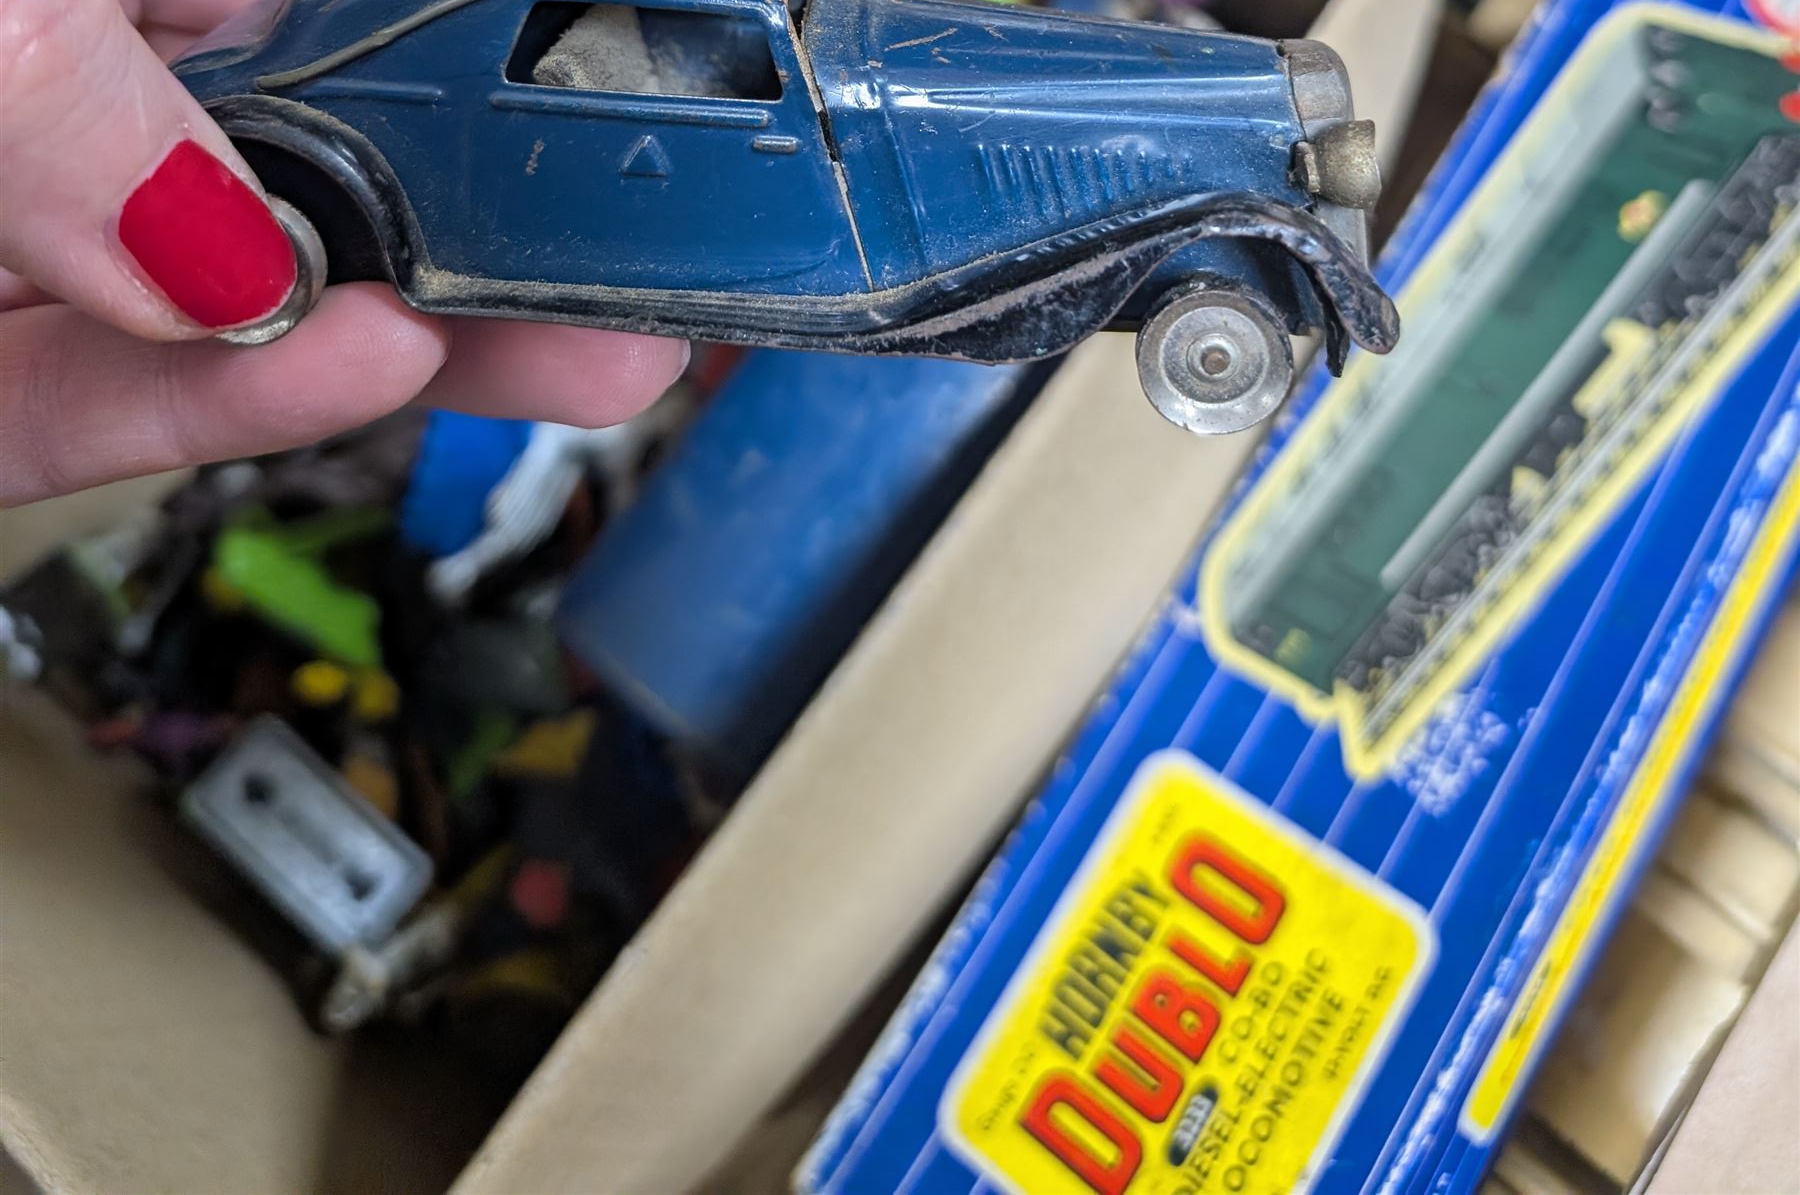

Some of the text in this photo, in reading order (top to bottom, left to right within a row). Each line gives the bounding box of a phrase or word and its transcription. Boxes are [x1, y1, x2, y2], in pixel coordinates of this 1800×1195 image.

[1016, 828, 1286, 1195] DUBLO
[1039, 868, 1171, 1061] HORNBY
[1216, 960, 1283, 1065] CO-BO
[1222, 987, 1345, 1194] OCOMOTIVE
